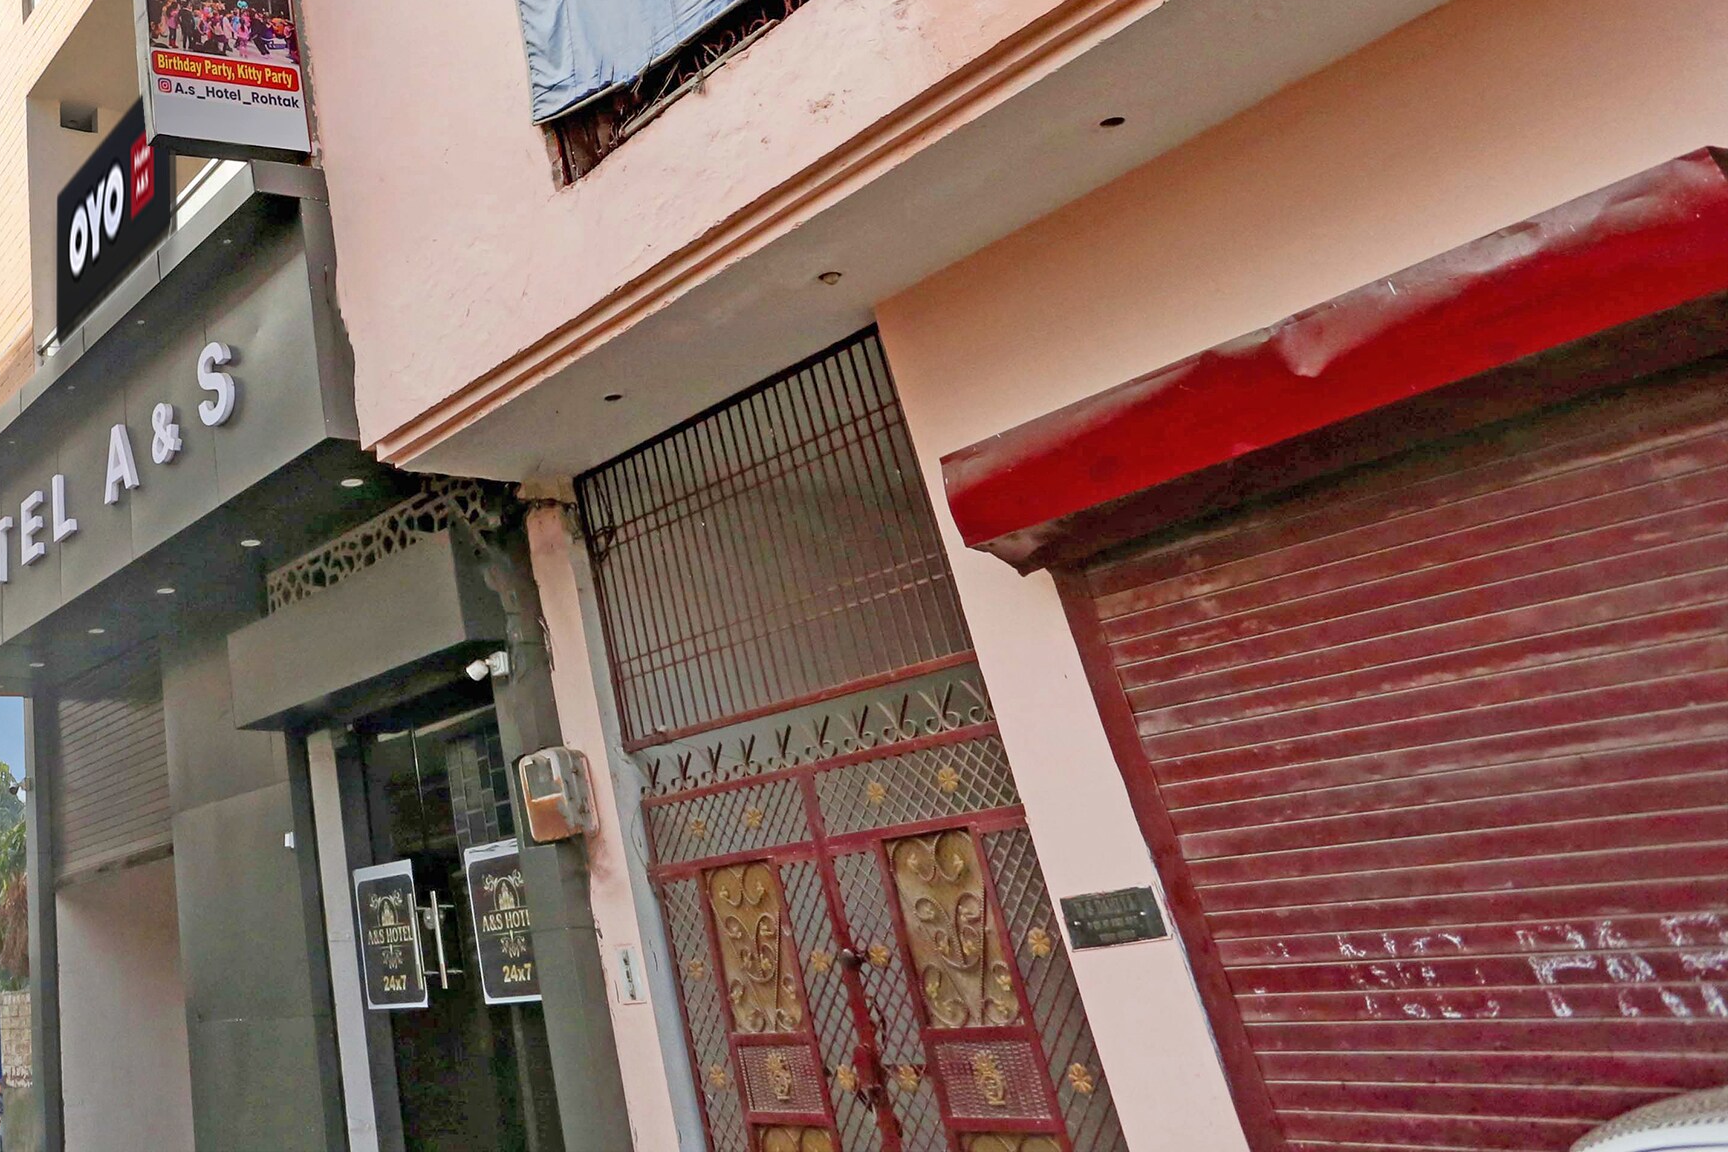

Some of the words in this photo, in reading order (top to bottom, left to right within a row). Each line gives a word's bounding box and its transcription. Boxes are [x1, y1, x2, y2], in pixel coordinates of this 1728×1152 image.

[157, 54, 202, 76] Birthday
[204, 60, 235, 80] Party,
[237, 64, 262, 84] Kitty
[265, 68, 293, 88] Party
[69, 163, 124, 276] OYO
[104, 423, 140, 504] A
[152, 402, 183, 464] &
[197, 342, 236, 426] S
[482, 913, 503, 932] A&S
[368, 929, 385, 945] A&S
[386, 926, 414, 943] HOTEL
[503, 963, 531, 982] 24x7
[384, 975, 406, 991] 24x7
